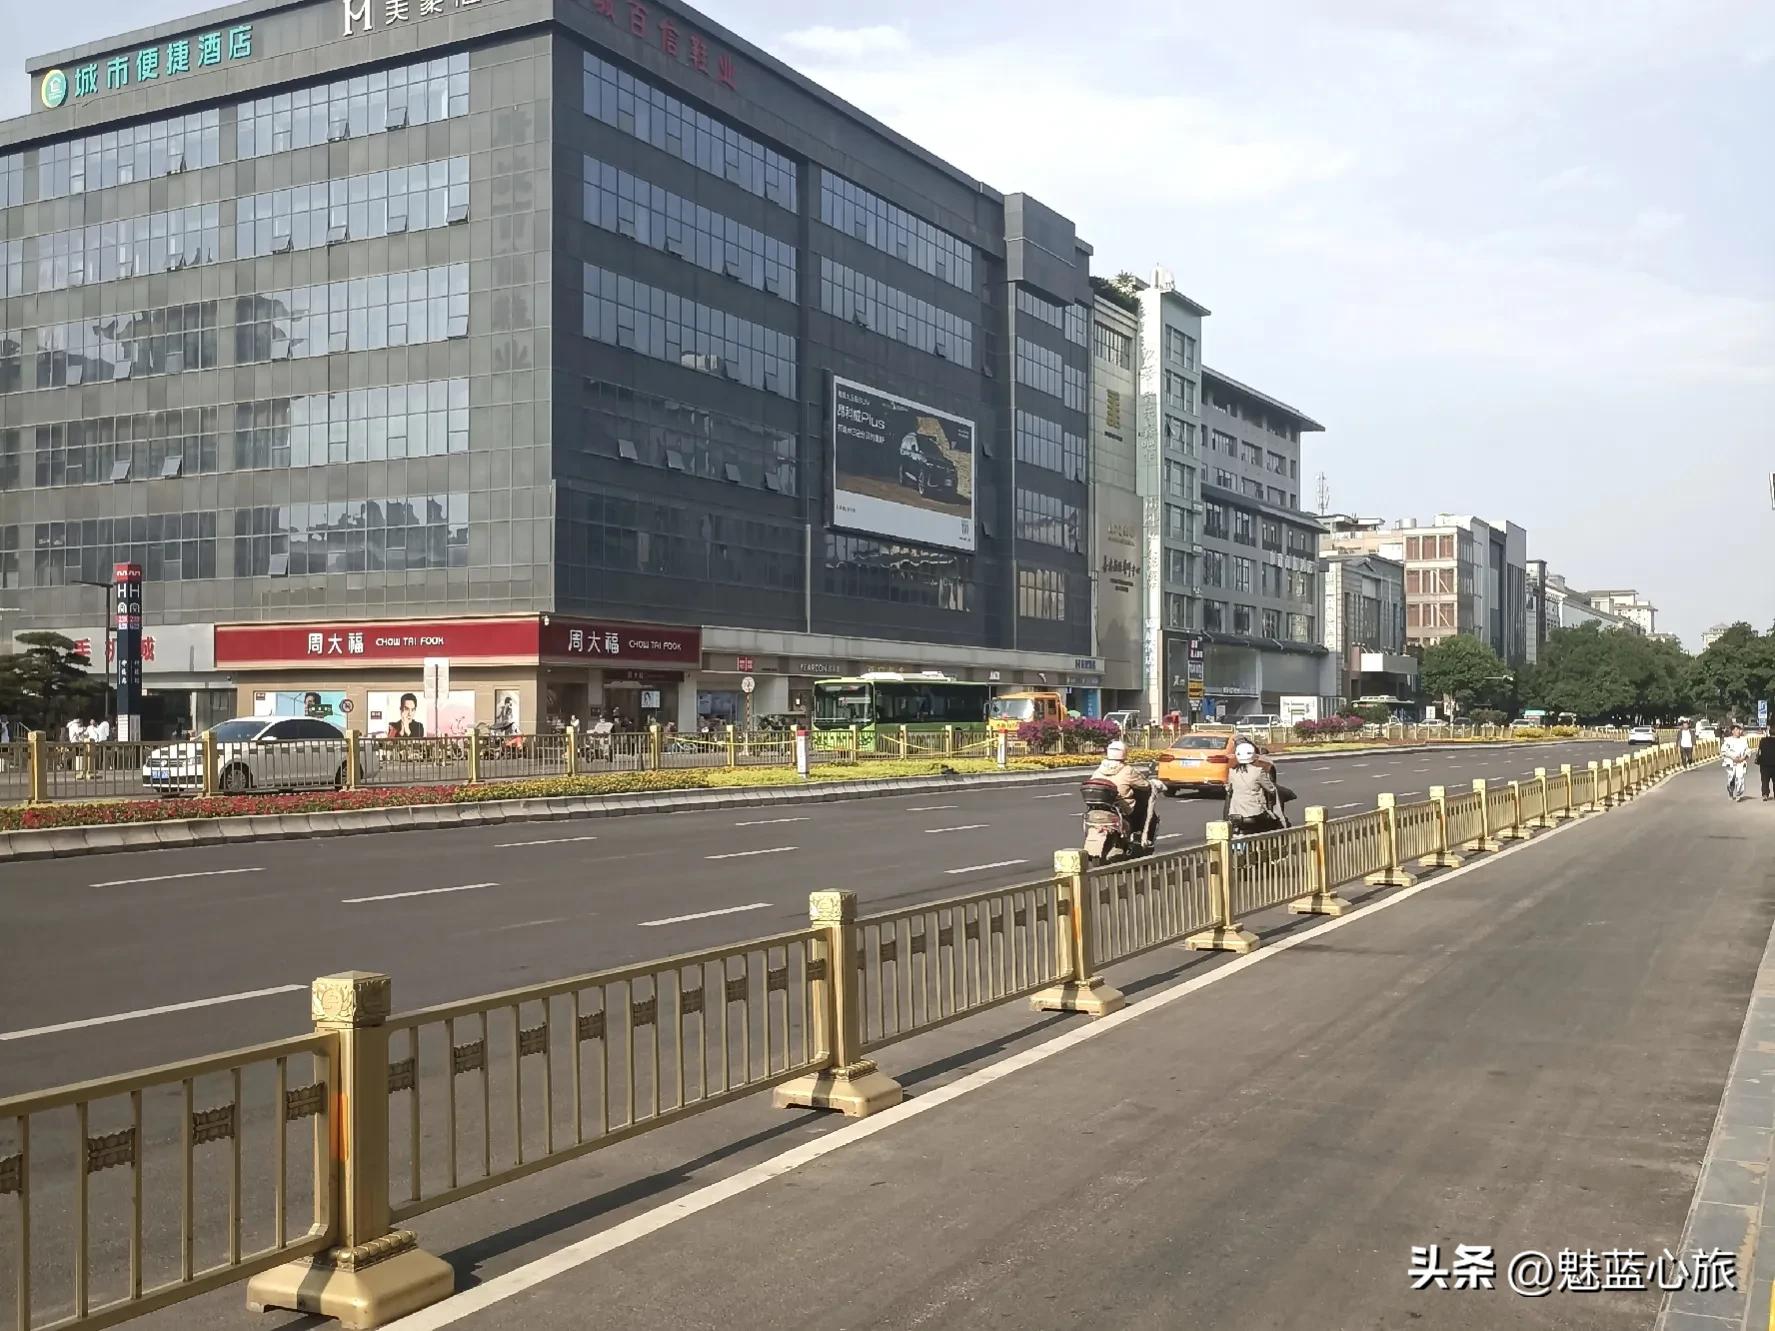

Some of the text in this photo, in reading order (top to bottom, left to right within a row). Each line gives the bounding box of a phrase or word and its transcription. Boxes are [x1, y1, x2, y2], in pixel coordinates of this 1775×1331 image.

[73, 24, 253, 98] 城市便捷酒店
[307, 632, 364, 655] 周大福
[375, 636, 444, 646] CHOW TAI FOOK
[568, 629, 620, 654] 周大福
[628, 639, 682, 651] CHOW TAI FOOK
